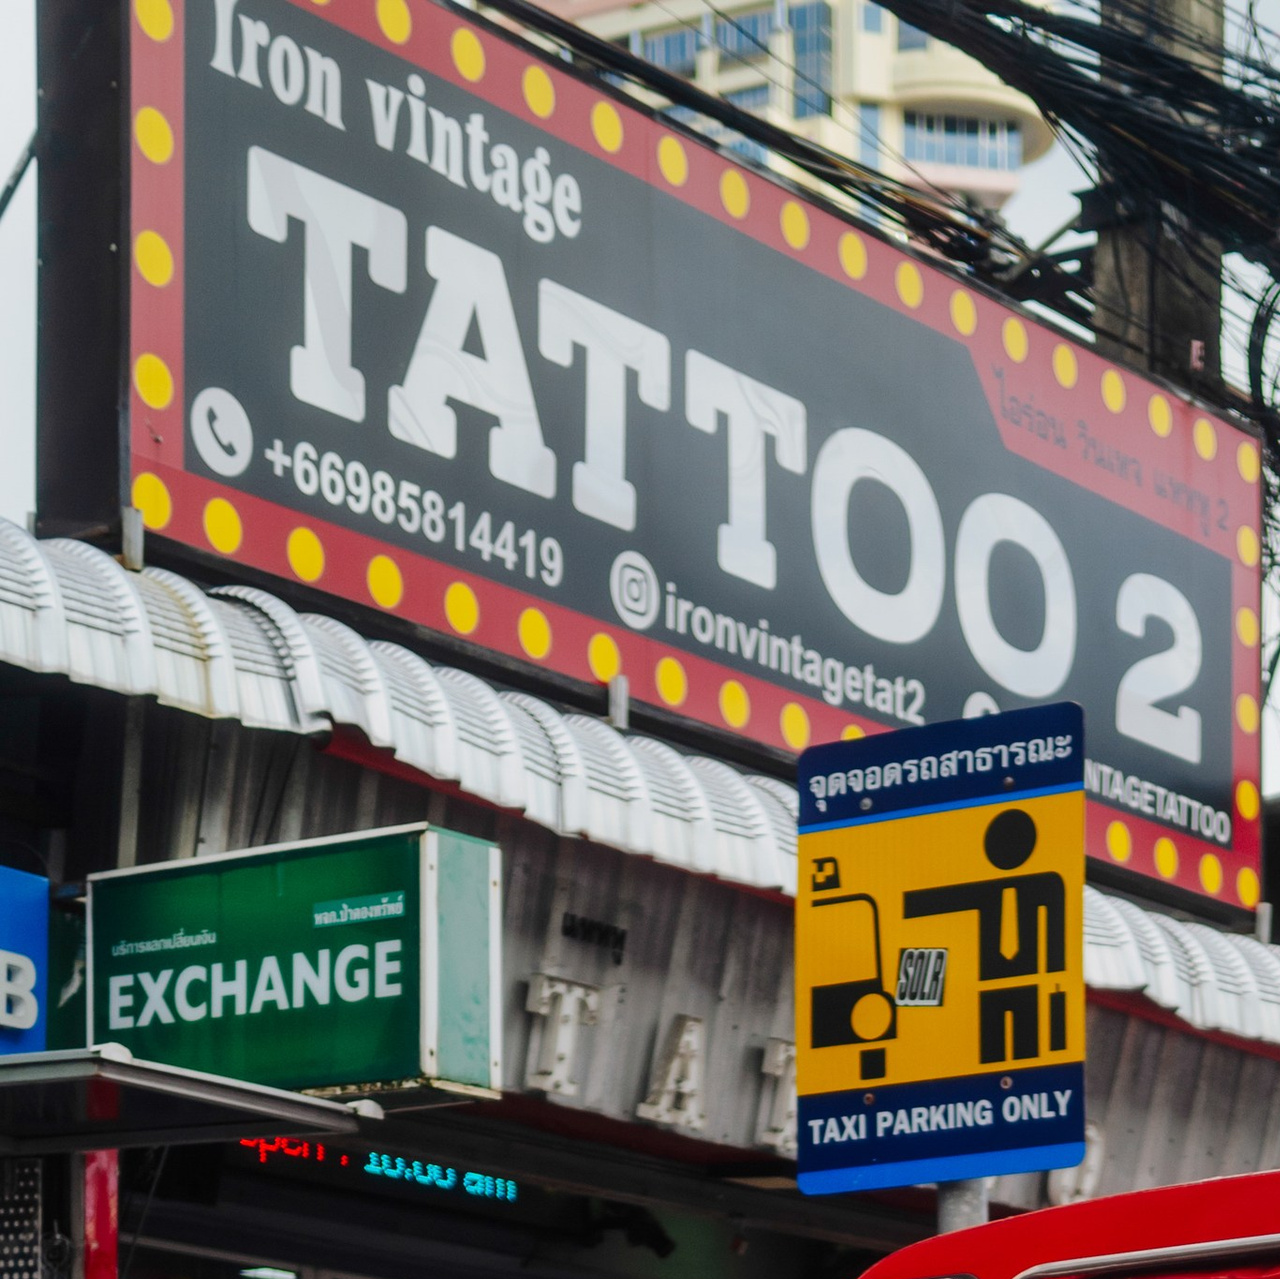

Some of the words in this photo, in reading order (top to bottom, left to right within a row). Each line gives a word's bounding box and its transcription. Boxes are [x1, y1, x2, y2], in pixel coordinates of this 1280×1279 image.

[210, 0, 346, 131] Iron
[365, 73, 583, 243] vintage
[246, 144, 1078, 700] TATTOO
[1114, 572, 1202, 765] 2
[264, 437, 564, 588] +66985814419
[664, 583, 926, 727] ironvintagetat2
[809, 733, 1073, 813] จุดจอดรถสาธารณะ
[108, 939, 402, 1030] EXCHANGE
[808, 1114, 867, 1146] TAXI
[876, 1099, 994, 1137] PARKING
[1001, 1089, 1073, 1123] ONLY
